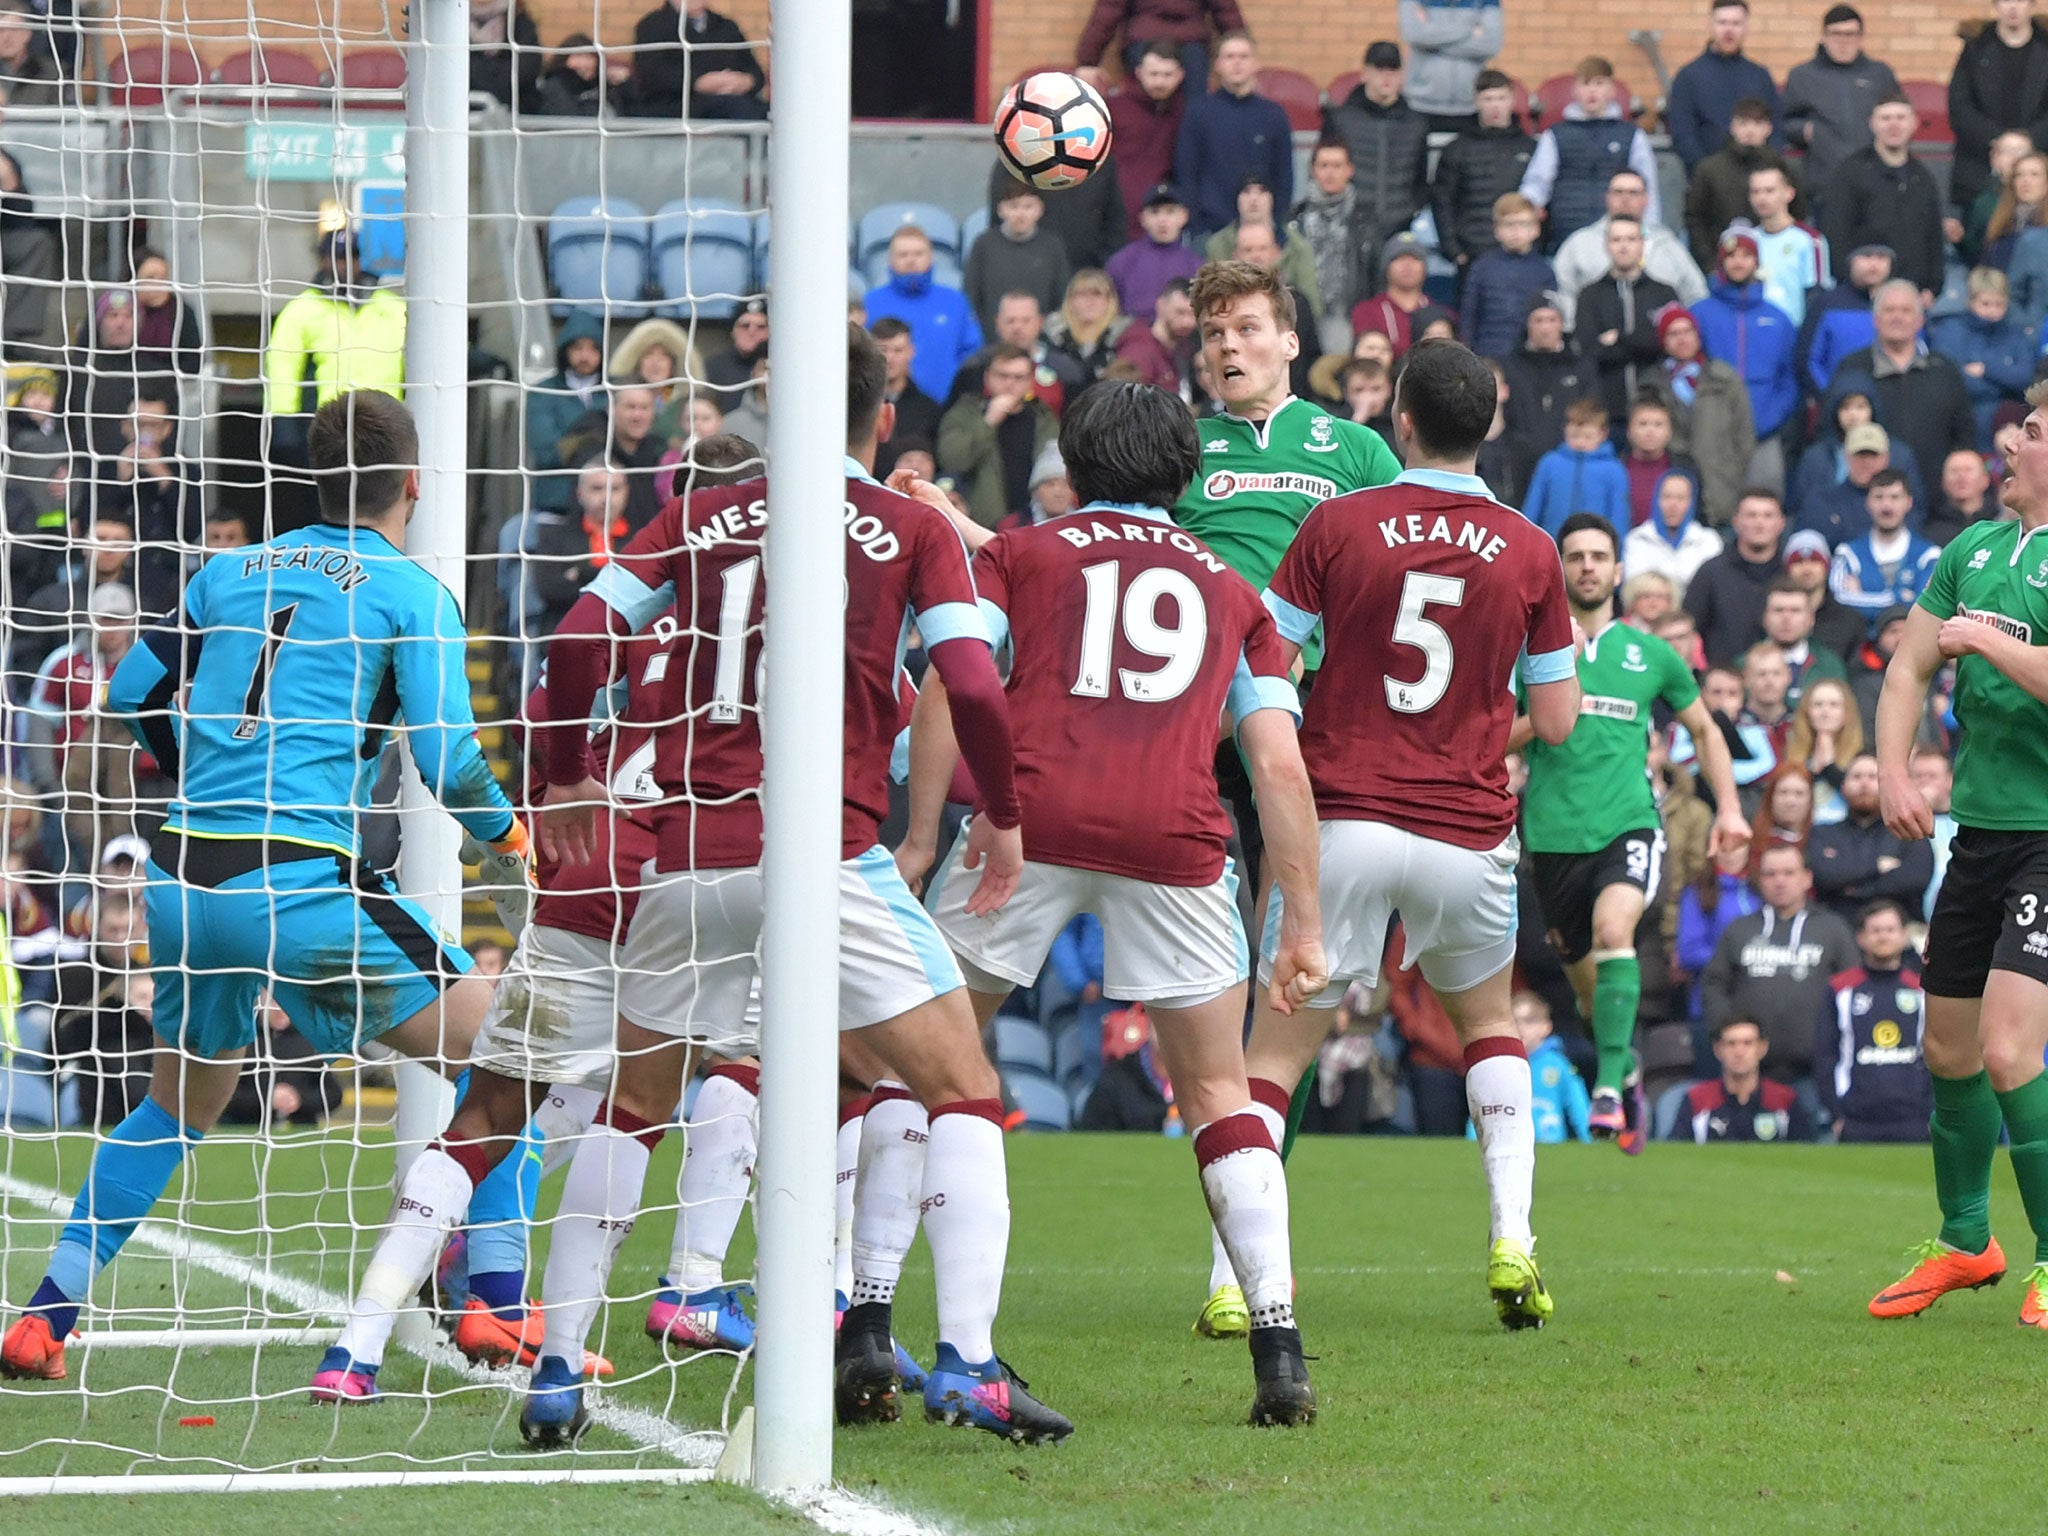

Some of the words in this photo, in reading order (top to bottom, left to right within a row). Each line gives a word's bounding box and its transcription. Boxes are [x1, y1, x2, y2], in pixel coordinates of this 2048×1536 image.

[252, 132, 320, 166] EXIT
[1238, 474, 1332, 498] vanarama
[685, 499, 900, 562] WESOD
[1057, 521, 1227, 574] BARTON
[1378, 515, 1507, 563] KEANE
[243, 544, 370, 593] HEATON
[1070, 559, 1207, 703] 19
[1382, 570, 1466, 714] 5
[232, 601, 300, 740] 1
[1625, 839, 1649, 870] 3
[2015, 893, 2048, 934] 3
[1481, 1104, 1516, 1117] BFC
[902, 1128, 929, 1144] BF
[836, 1167, 858, 1186] BF
[398, 1197, 434, 1218] BFC
[920, 1192, 946, 1216] BFC
[678, 1315, 718, 1345] adidas
